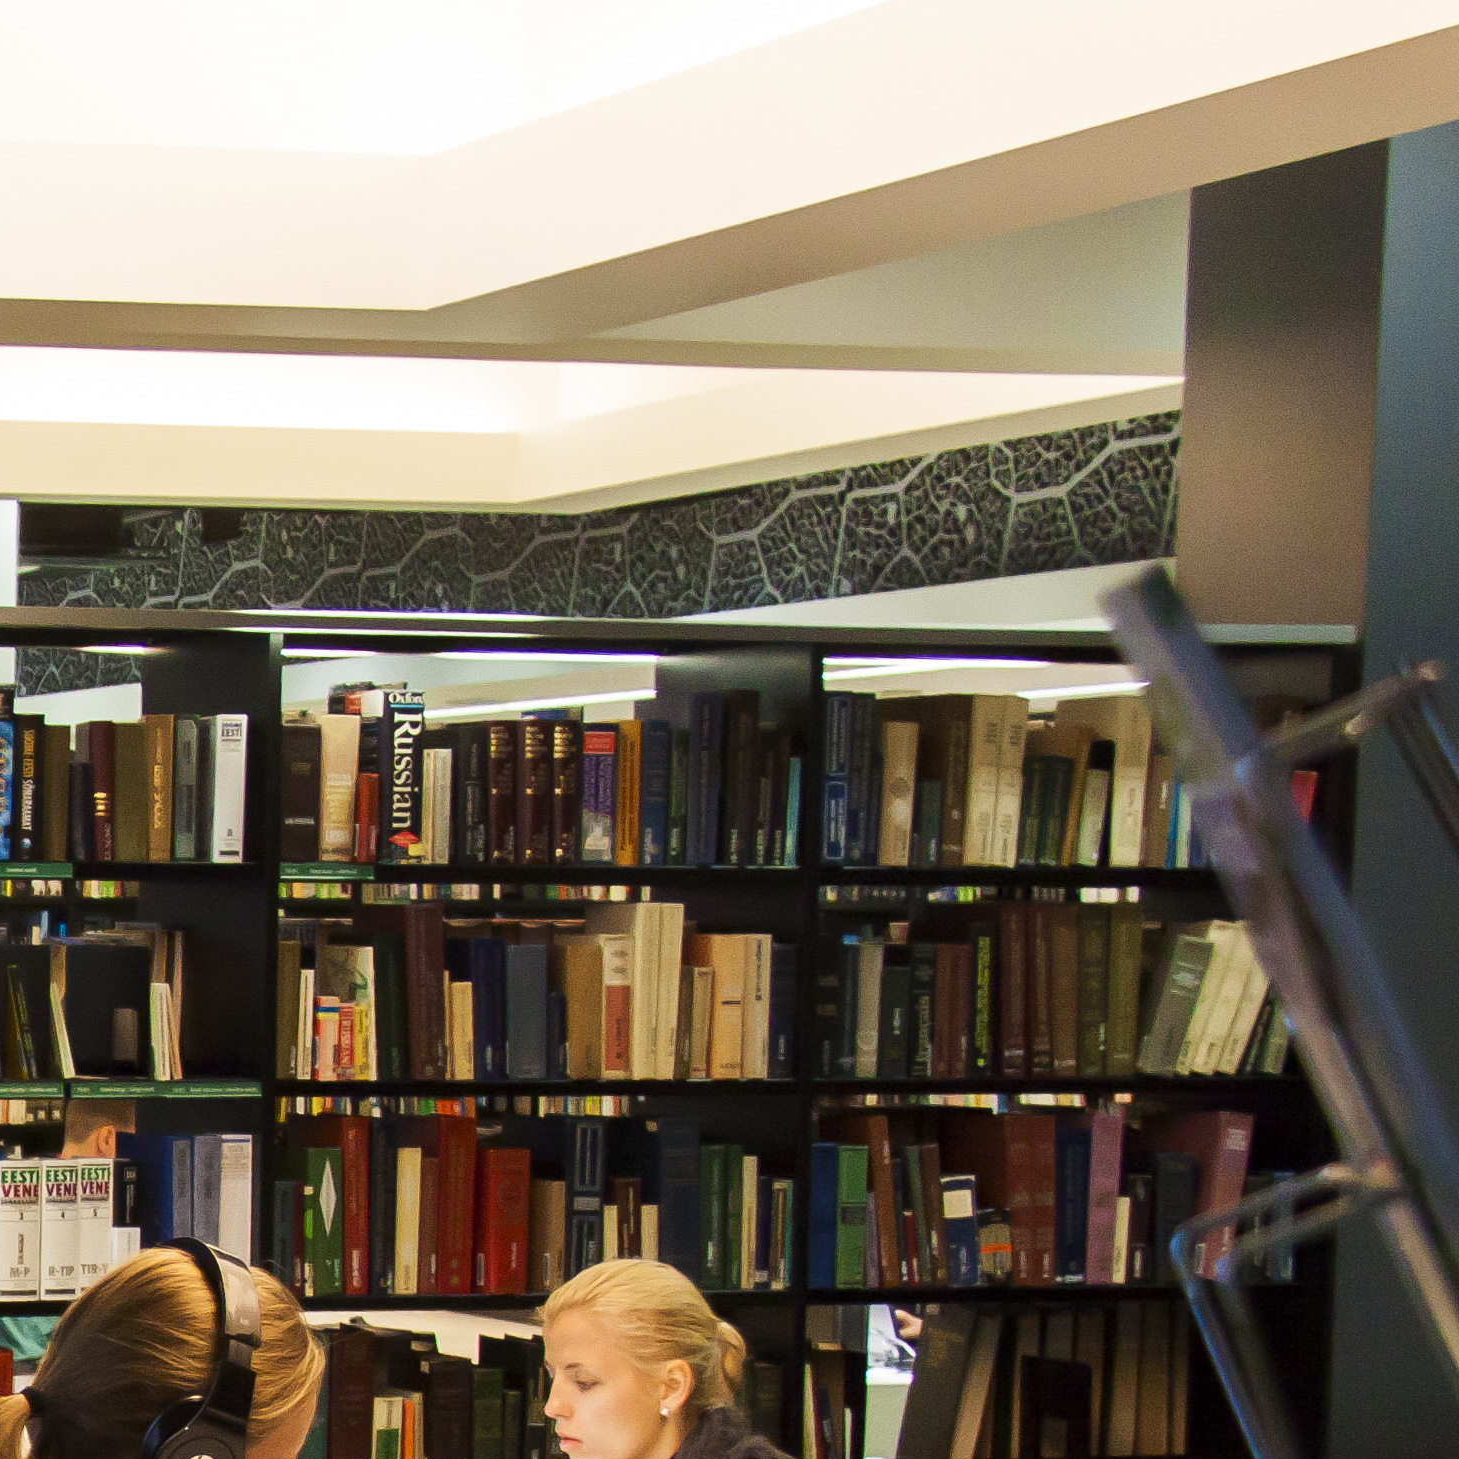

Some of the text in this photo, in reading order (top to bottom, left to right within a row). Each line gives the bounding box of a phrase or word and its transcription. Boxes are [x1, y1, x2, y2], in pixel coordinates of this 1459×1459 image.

[387, 691, 424, 705] Oxford
[390, 712, 423, 830] Russian
[1, 1170, 41, 1184] EESTI
[45, 1169, 78, 1183] EESTI
[80, 1167, 111, 1181] EESTI
[1, 1183, 39, 1198] VENE
[45, 1182, 78, 1197] VENE
[80, 1180, 110, 1195] VENE
